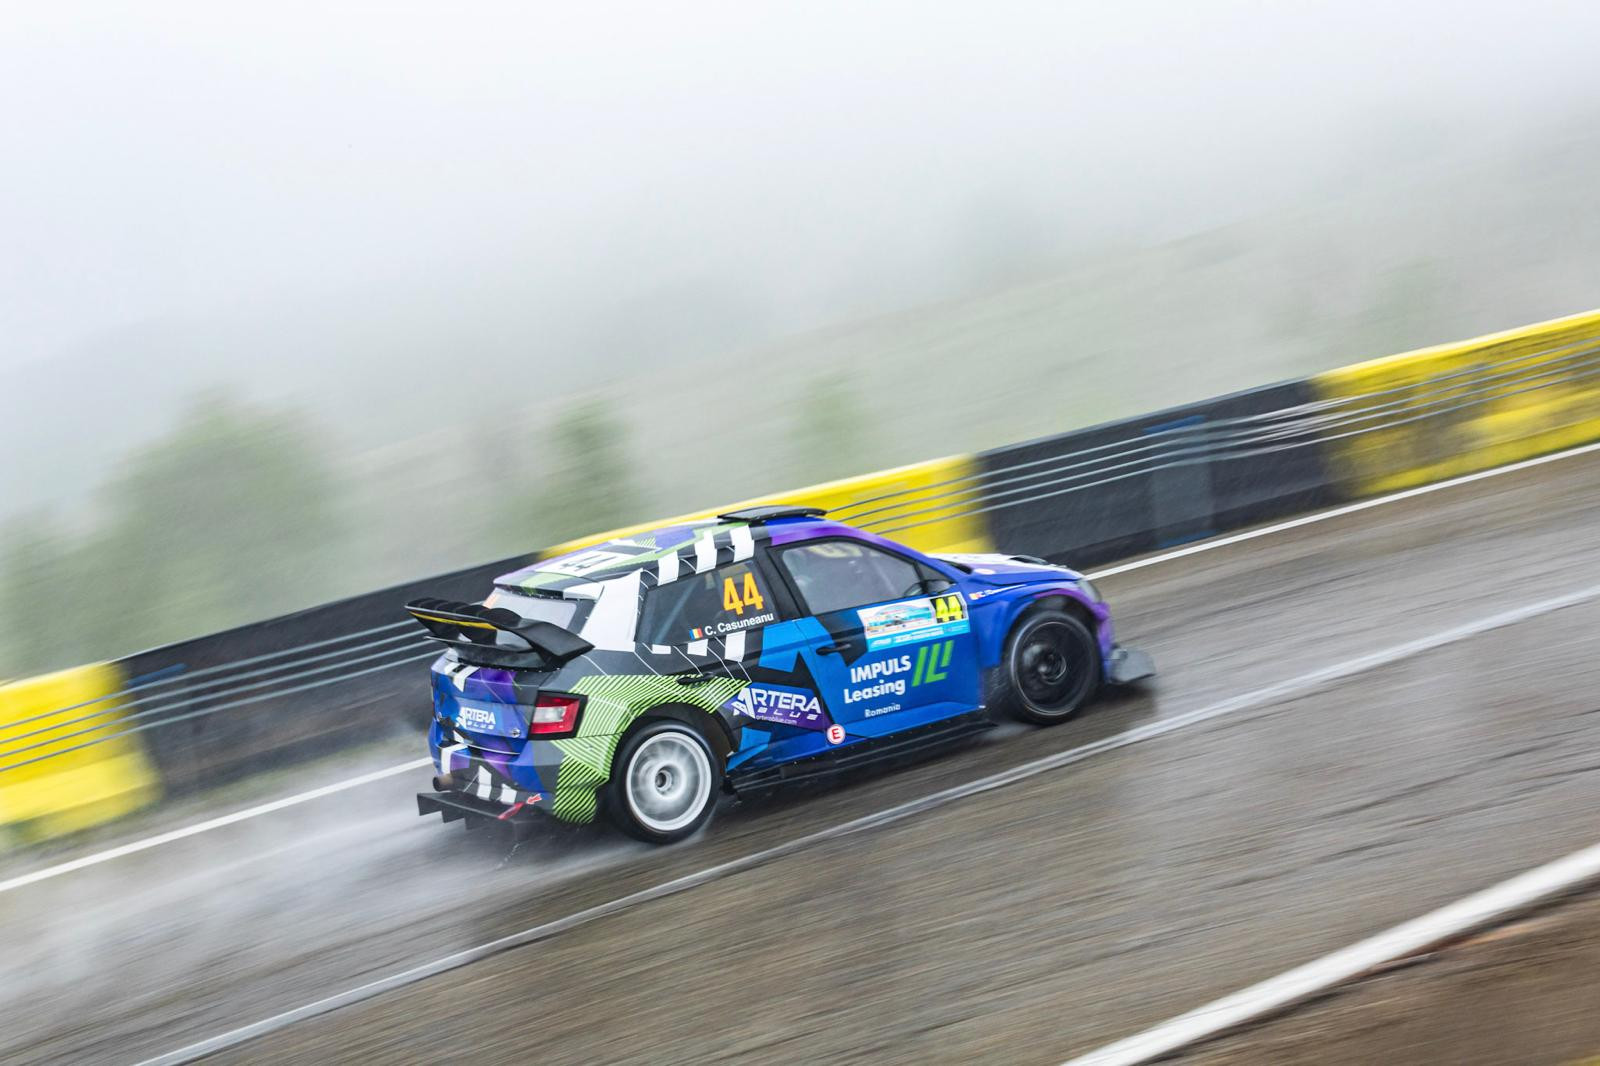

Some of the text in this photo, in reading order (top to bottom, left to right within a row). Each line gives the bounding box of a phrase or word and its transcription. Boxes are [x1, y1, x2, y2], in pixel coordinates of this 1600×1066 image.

[723, 572, 764, 615] 44
[935, 595, 963, 623] 44
[704, 613, 774, 636] C. Casuneanu
[850, 655, 912, 684] IMPULS
[731, 687, 821, 719] ARTERA
[843, 679, 906, 704] Leasing
[456, 707, 497, 729] ARTERA
[864, 703, 901, 718] Romania
[831, 728, 841, 740] E
